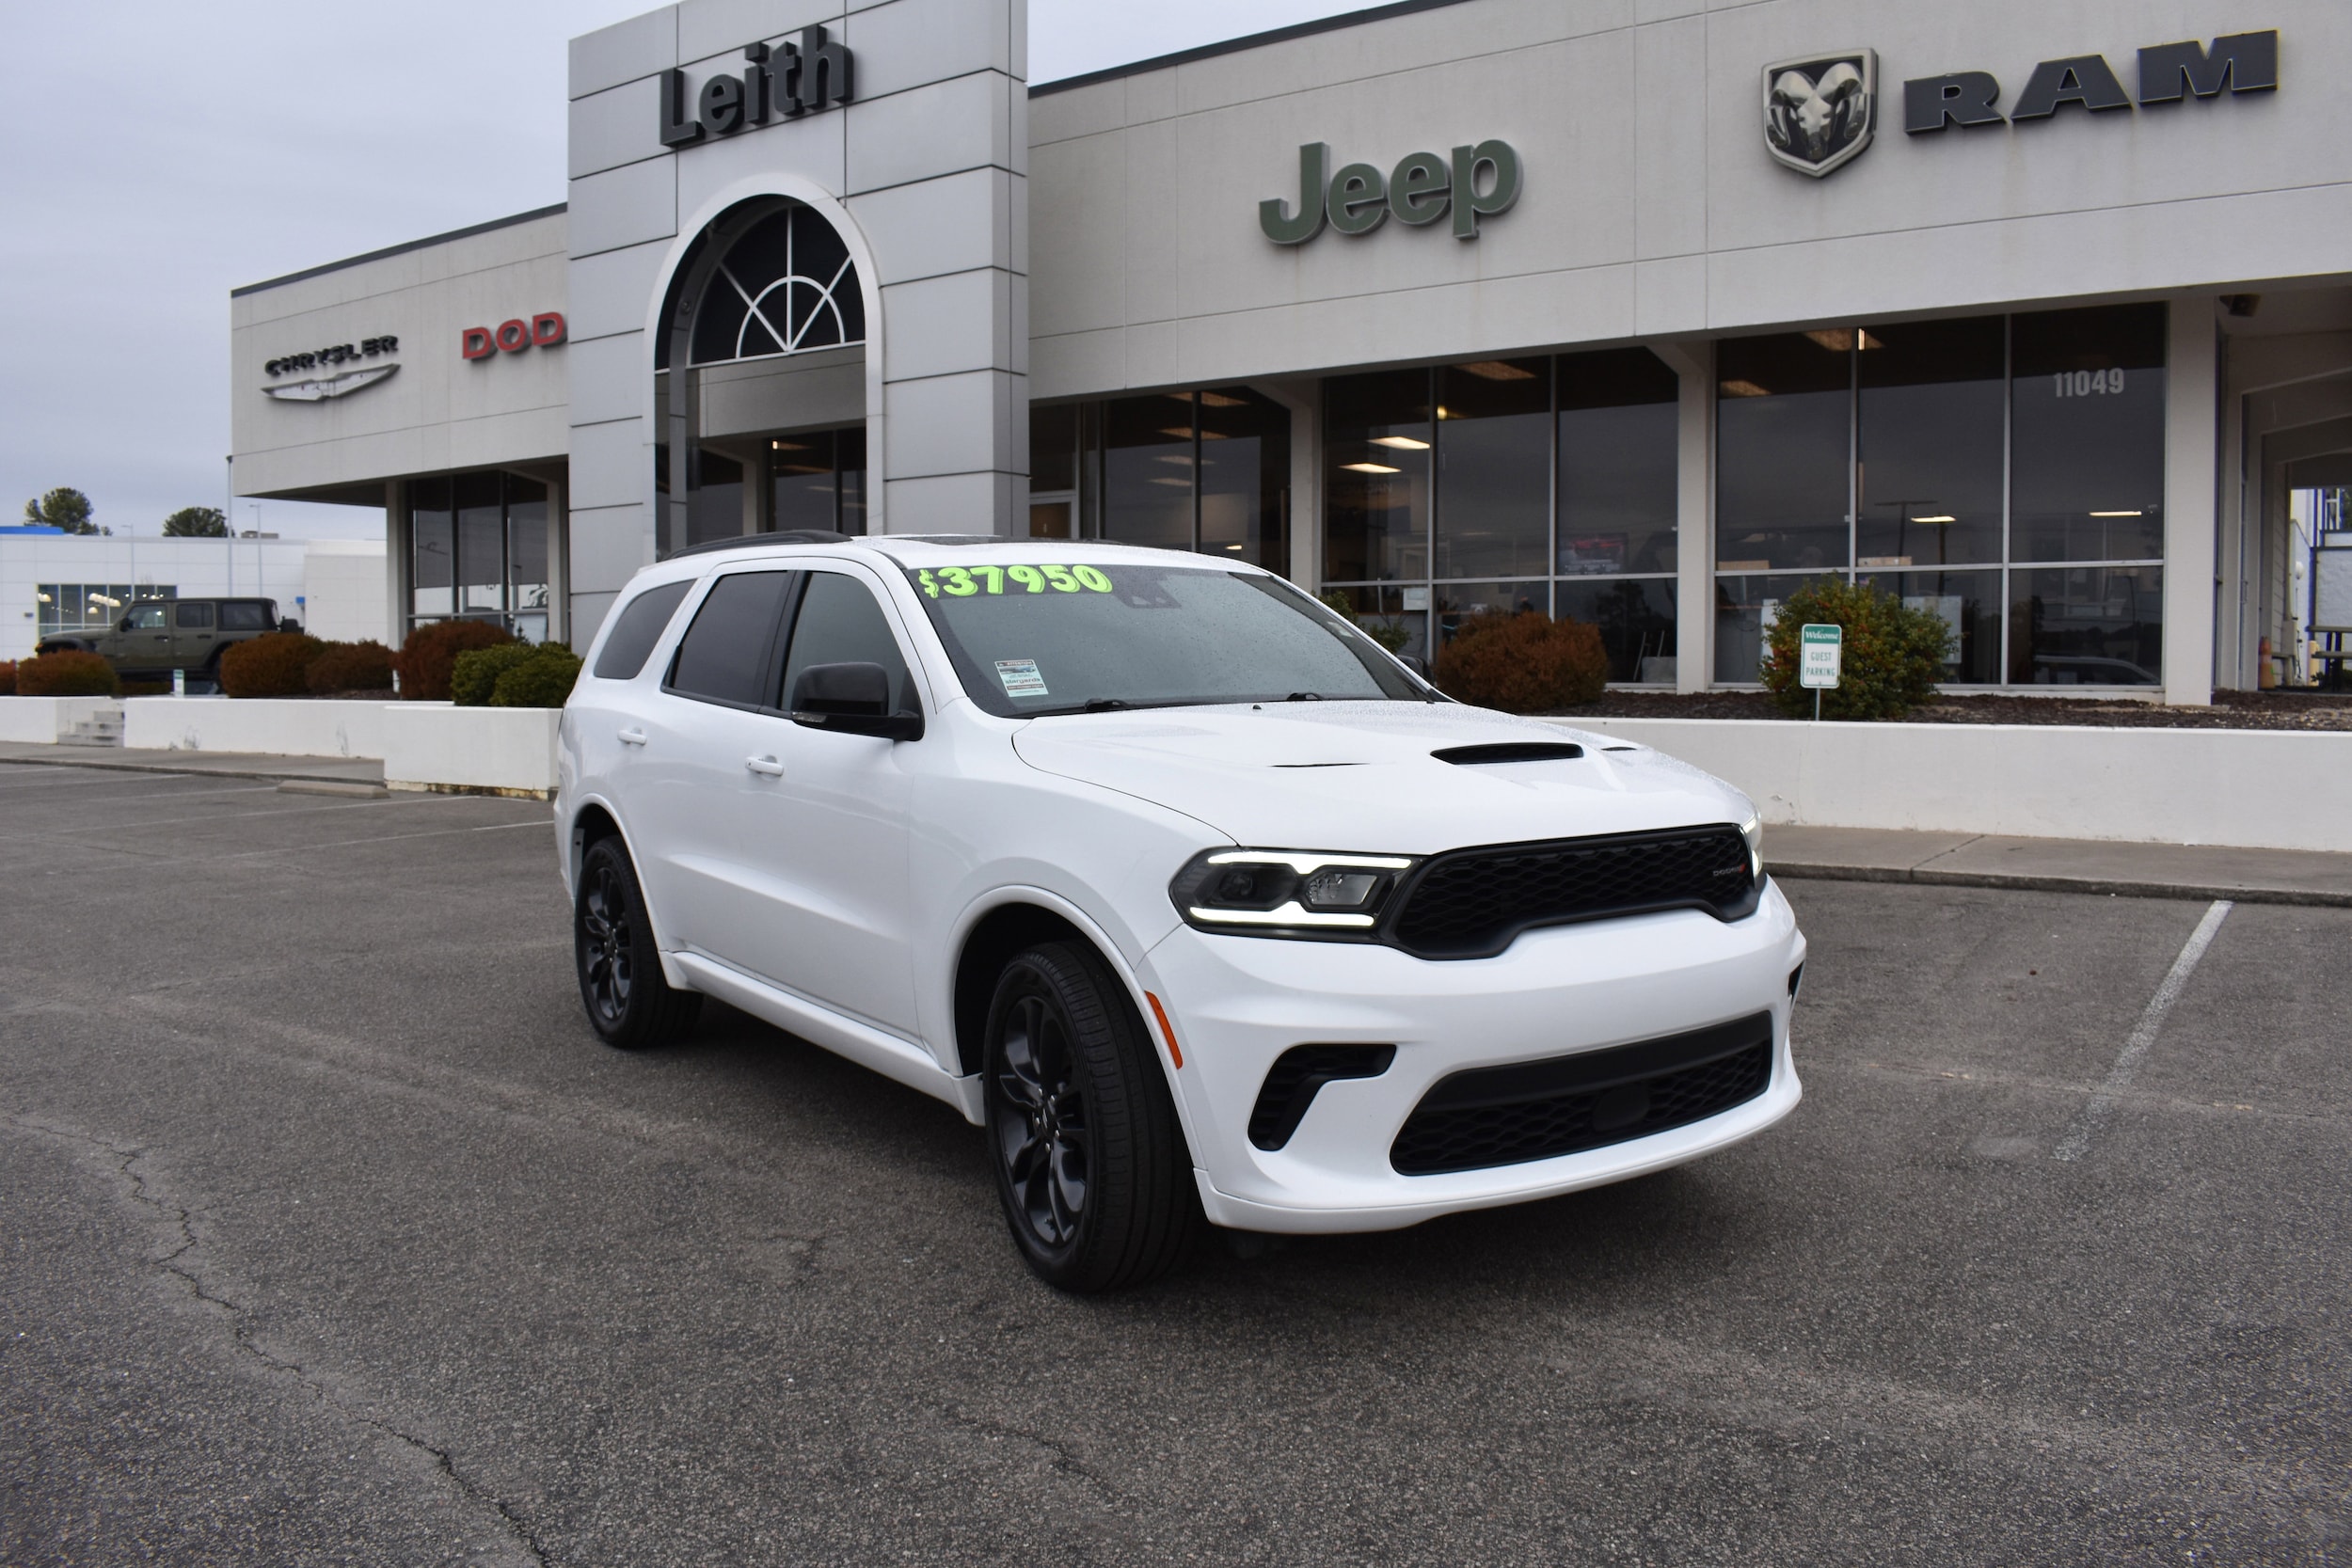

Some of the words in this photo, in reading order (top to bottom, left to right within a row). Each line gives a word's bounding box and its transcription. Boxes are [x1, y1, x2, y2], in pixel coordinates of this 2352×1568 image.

[660, 24, 854, 148] Leith
[1902, 29, 2279, 135] RAM
[1259, 139, 1524, 245] Jeep
[264, 335, 399, 376] CHRYSLER
[2054, 368, 2125, 397] 11049
[918, 564, 1113, 598] $37950
[1805, 631, 1838, 640] Welcome
[1806, 667, 1836, 676] PARKING
[1810, 652, 1832, 661] GUEST
